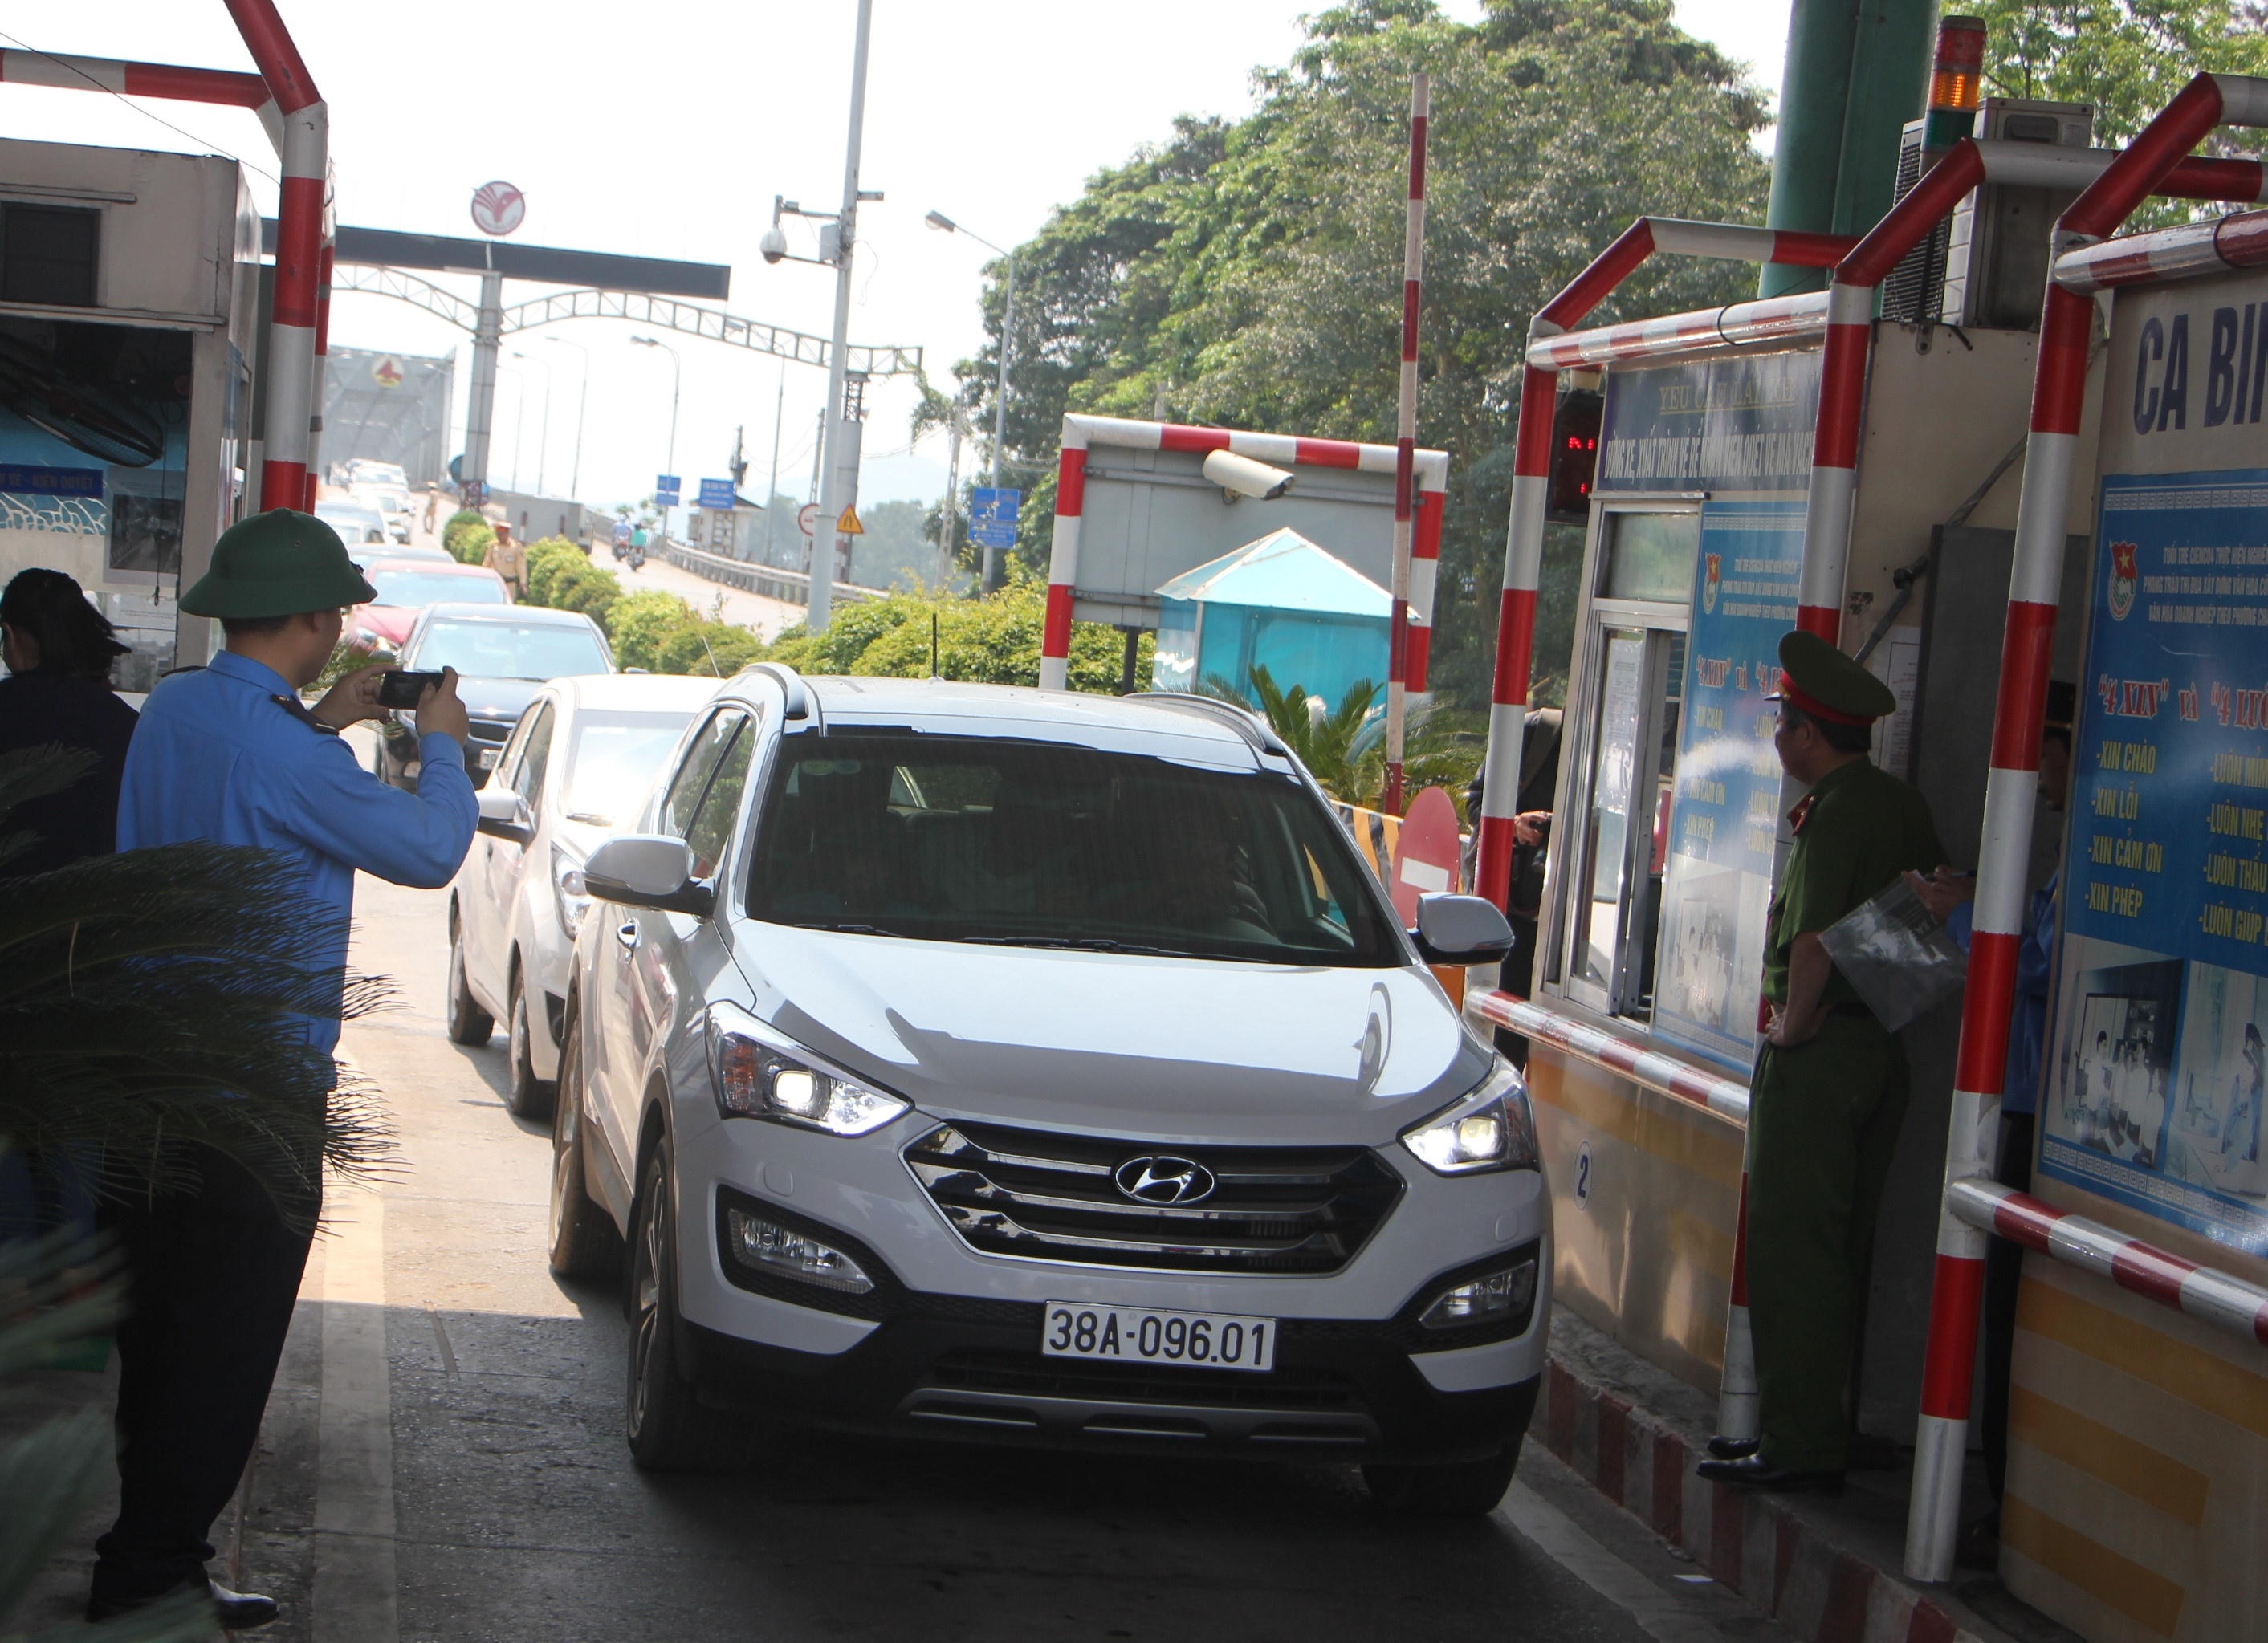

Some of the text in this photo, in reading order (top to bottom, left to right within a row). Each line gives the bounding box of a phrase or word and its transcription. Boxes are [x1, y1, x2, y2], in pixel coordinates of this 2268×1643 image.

[1659, 376, 1690, 410] YÊU
[2133, 314, 2189, 435] CA
[2123, 738, 2156, 775] CHÀO
[2119, 781, 2140, 820] LỖI
[2241, 807, 2265, 848] NHẸ
[2115, 828, 2144, 870] CẢM
[2238, 850, 2268, 893] THẤU
[2111, 884, 2144, 918] PHÉP
[2235, 905, 2262, 944] GIÚP
[1578, 1154, 1589, 1198] 2
[1048, 1308, 1265, 1366] 38A-096.01
